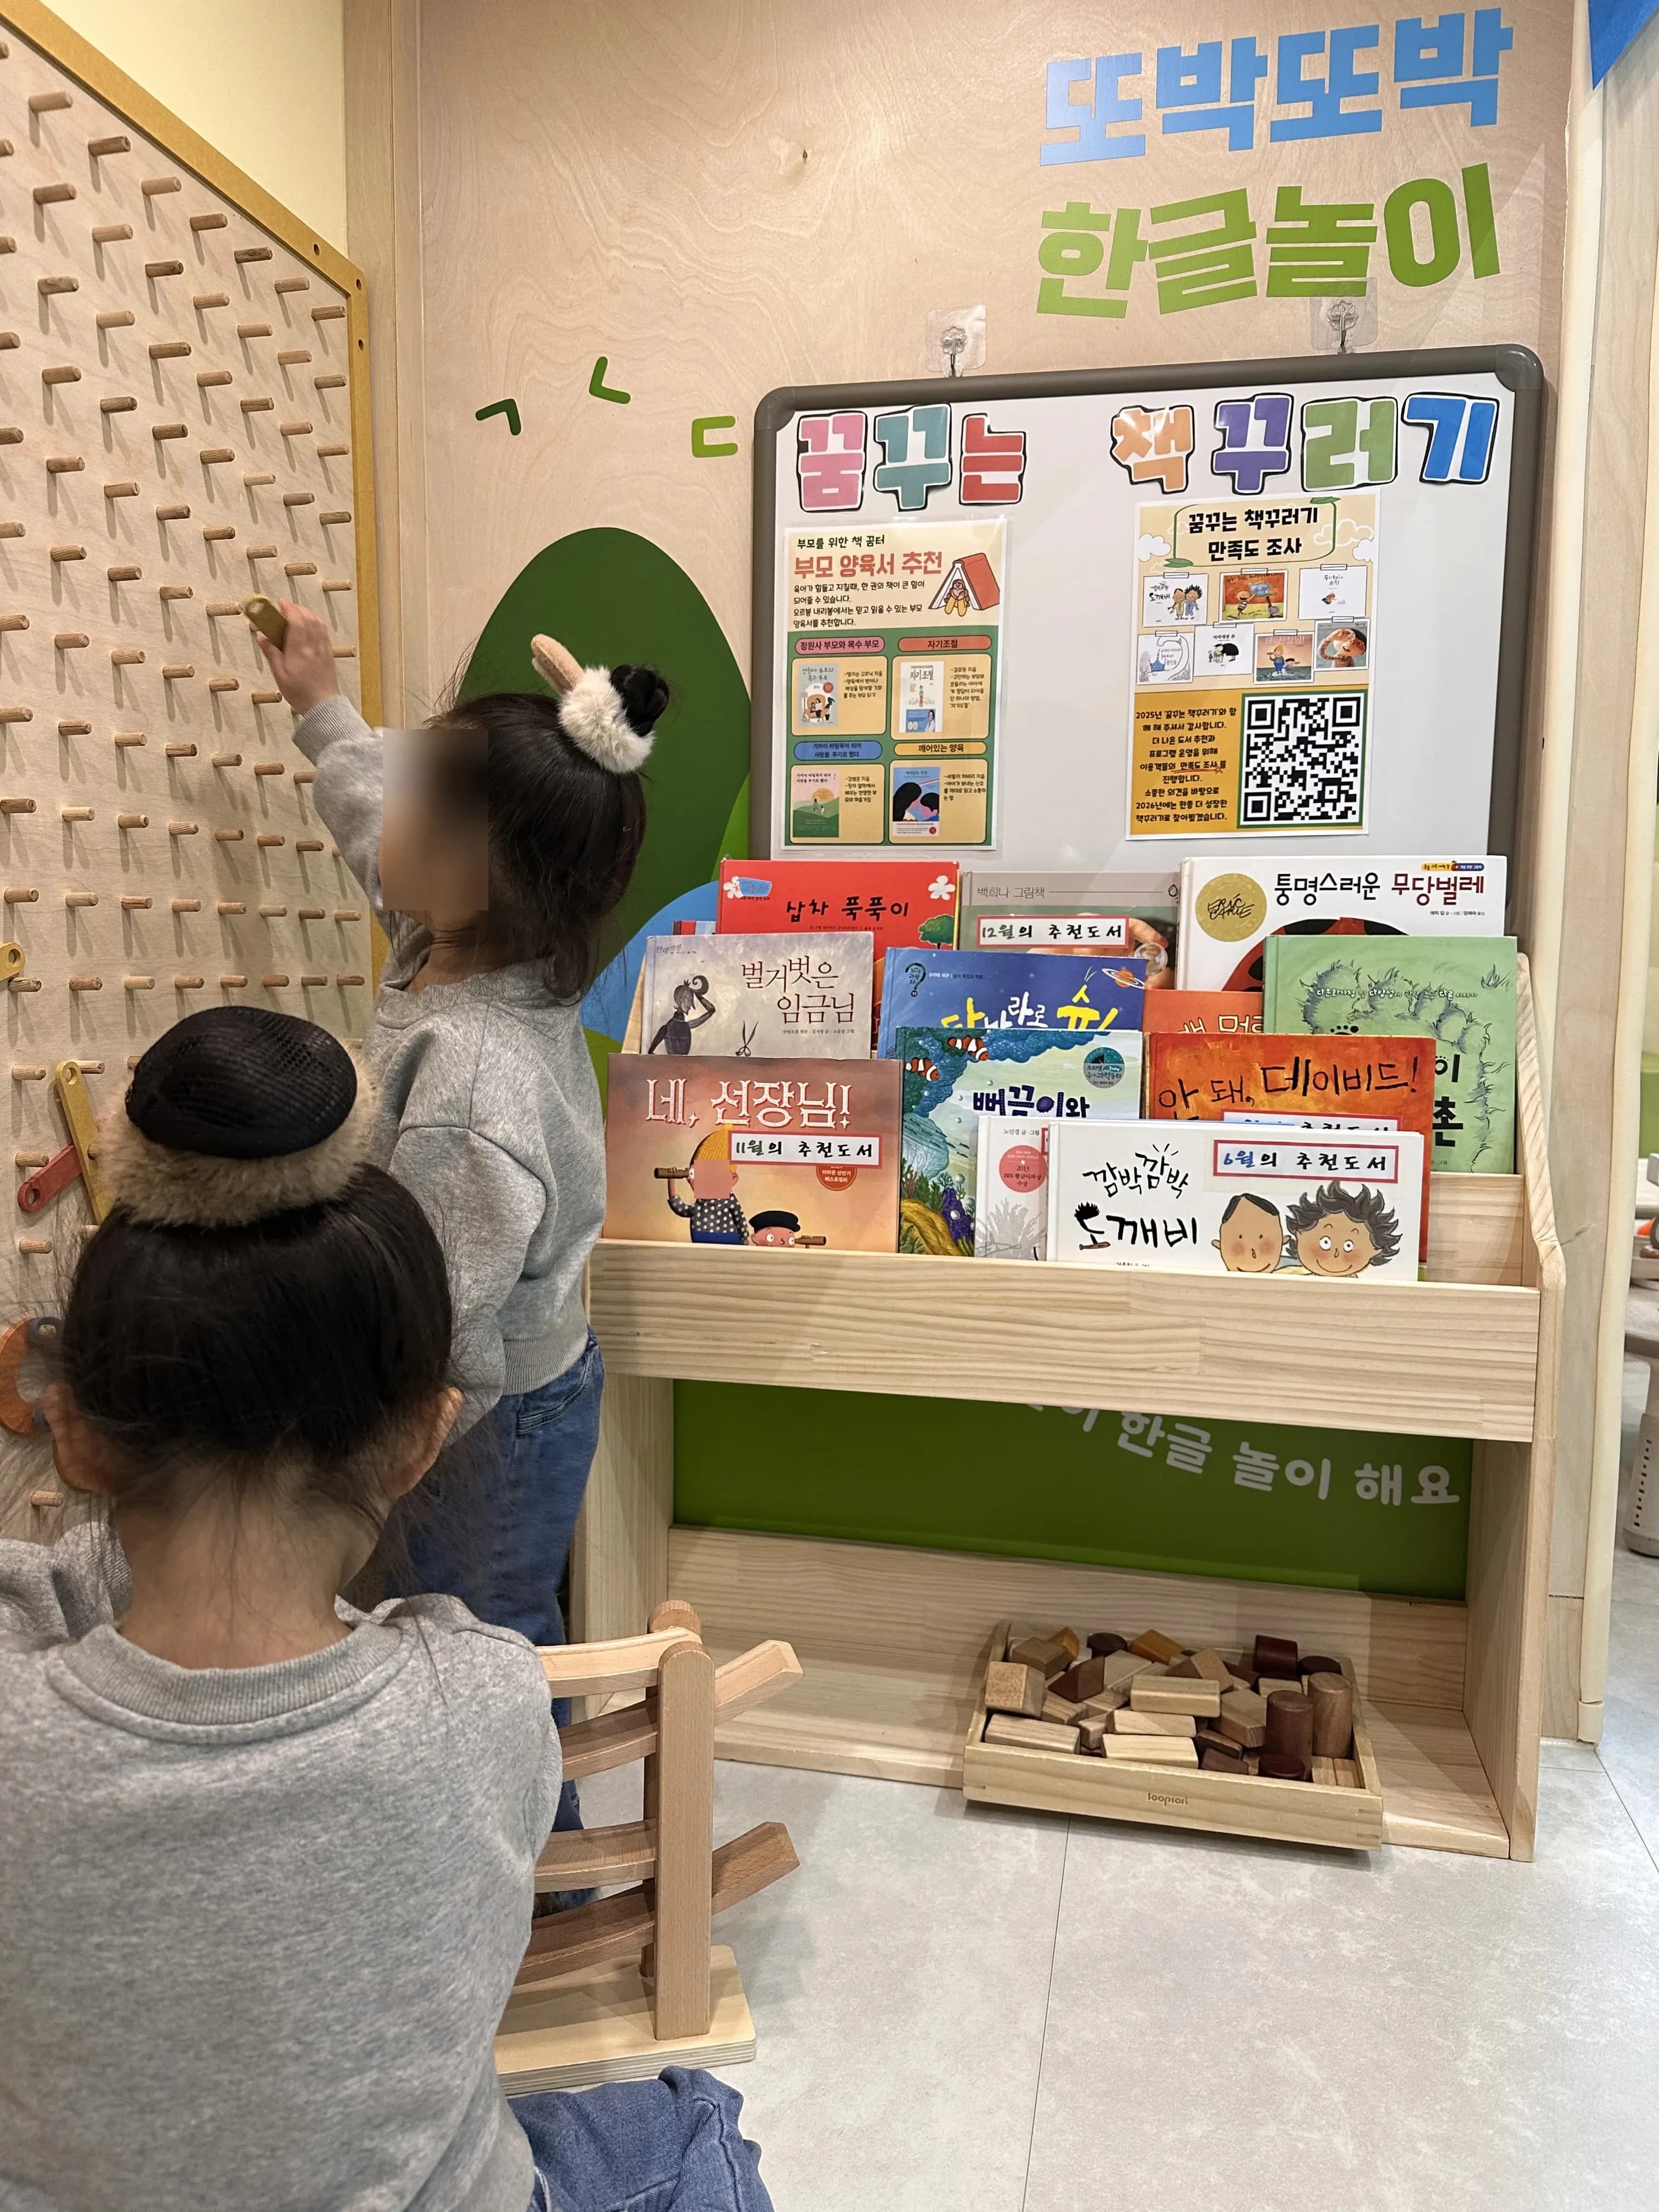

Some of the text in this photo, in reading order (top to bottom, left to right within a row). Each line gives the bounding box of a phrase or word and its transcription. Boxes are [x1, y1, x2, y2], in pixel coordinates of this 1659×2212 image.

[1040, 8, 1514, 166] 또박또박
[1037, 163, 1500, 318] 한글놀이
[797, 405, 1025, 510] 꿈꾸는
[1189, 507, 1318, 533] 꿈꾸는 책꾸러기
[797, 535, 885, 549] 부모를 위한 책 꿈터
[1209, 538, 1301, 561] 만족도 조사
[794, 551, 942, 579] 부모 양육서 추천
[794, 580, 925, 594] 육아가 힘들고 지칠때, 한 권의 책이 큰 힘이
[794, 595, 851, 605] 되어줄 수 있습니다.
[856, 606, 869, 614] 믿고
[871, 606, 884, 614] 읽을
[886, 606, 893, 614] 수
[894, 605, 907, 613] 있는
[910, 605, 923, 613] 부모
[793, 618, 856, 629] 양육서를 추천합니다.
[800, 642, 822, 651] 정원사
[824, 641, 845, 650] 부모와
[848, 641, 862, 649] 목수
[928, 639, 958, 649] 자기조절
[910, 669, 933, 681] 자기조절
[1136, 711, 1161, 719] 2025년
[1229, 708, 1237, 716] 함
[1164, 724, 1184, 732] 주셔서
[1187, 721, 1227, 731] 감사합니다.
[1161, 736, 1176, 745] 나은
[1178, 736, 1192, 744] 도서
[1194, 735, 1215, 744] 추천과
[918, 743, 964, 753] 깨어있는 양육
[1149, 748, 1218, 758] 프로그램 운영을 위해
[1140, 762, 1176, 772] 이용객들의
[1180, 761, 1201, 770] 만족도
[1163, 775, 1202, 784] 진행합니다.
[1145, 787, 1220, 797] 소중한 의견을 바탕으로
[1136, 802, 1177, 810] 2026년에는
[1179, 800, 1193, 809] 한층
[1205, 799, 1227, 809] 성장한
[1136, 813, 1227, 823] 책꾸러기로 찾아뵙겠습니다.
[977, 887, 1045, 899] 백희나 그림책
[1274, 872, 1484, 906] 퉁명스러운 무당벌레
[786, 896, 909, 923] 삽차 푹푹이
[982, 924, 1121, 940] 12월의 추천도서
[741, 956, 838, 993] 벌거벗은
[777, 993, 854, 1024] 임금님
[1210, 1075, 1255, 1108] 돼,
[1260, 1056, 1418, 1097] 데이비드!
[645, 1079, 853, 1130] 네, 선장님!
[736, 1139, 873, 1159] 11월의 추천도서
[1223, 1150, 1386, 1171] 6월의 추천도서
[1082, 1152, 1189, 1199] 깜박깜박
[1074, 1201, 1198, 1250] 도깨비
[1117, 1412, 1213, 1474] 한글
[1232, 1441, 1332, 1500] 놀이
[1354, 1463, 1460, 1506] 해요
